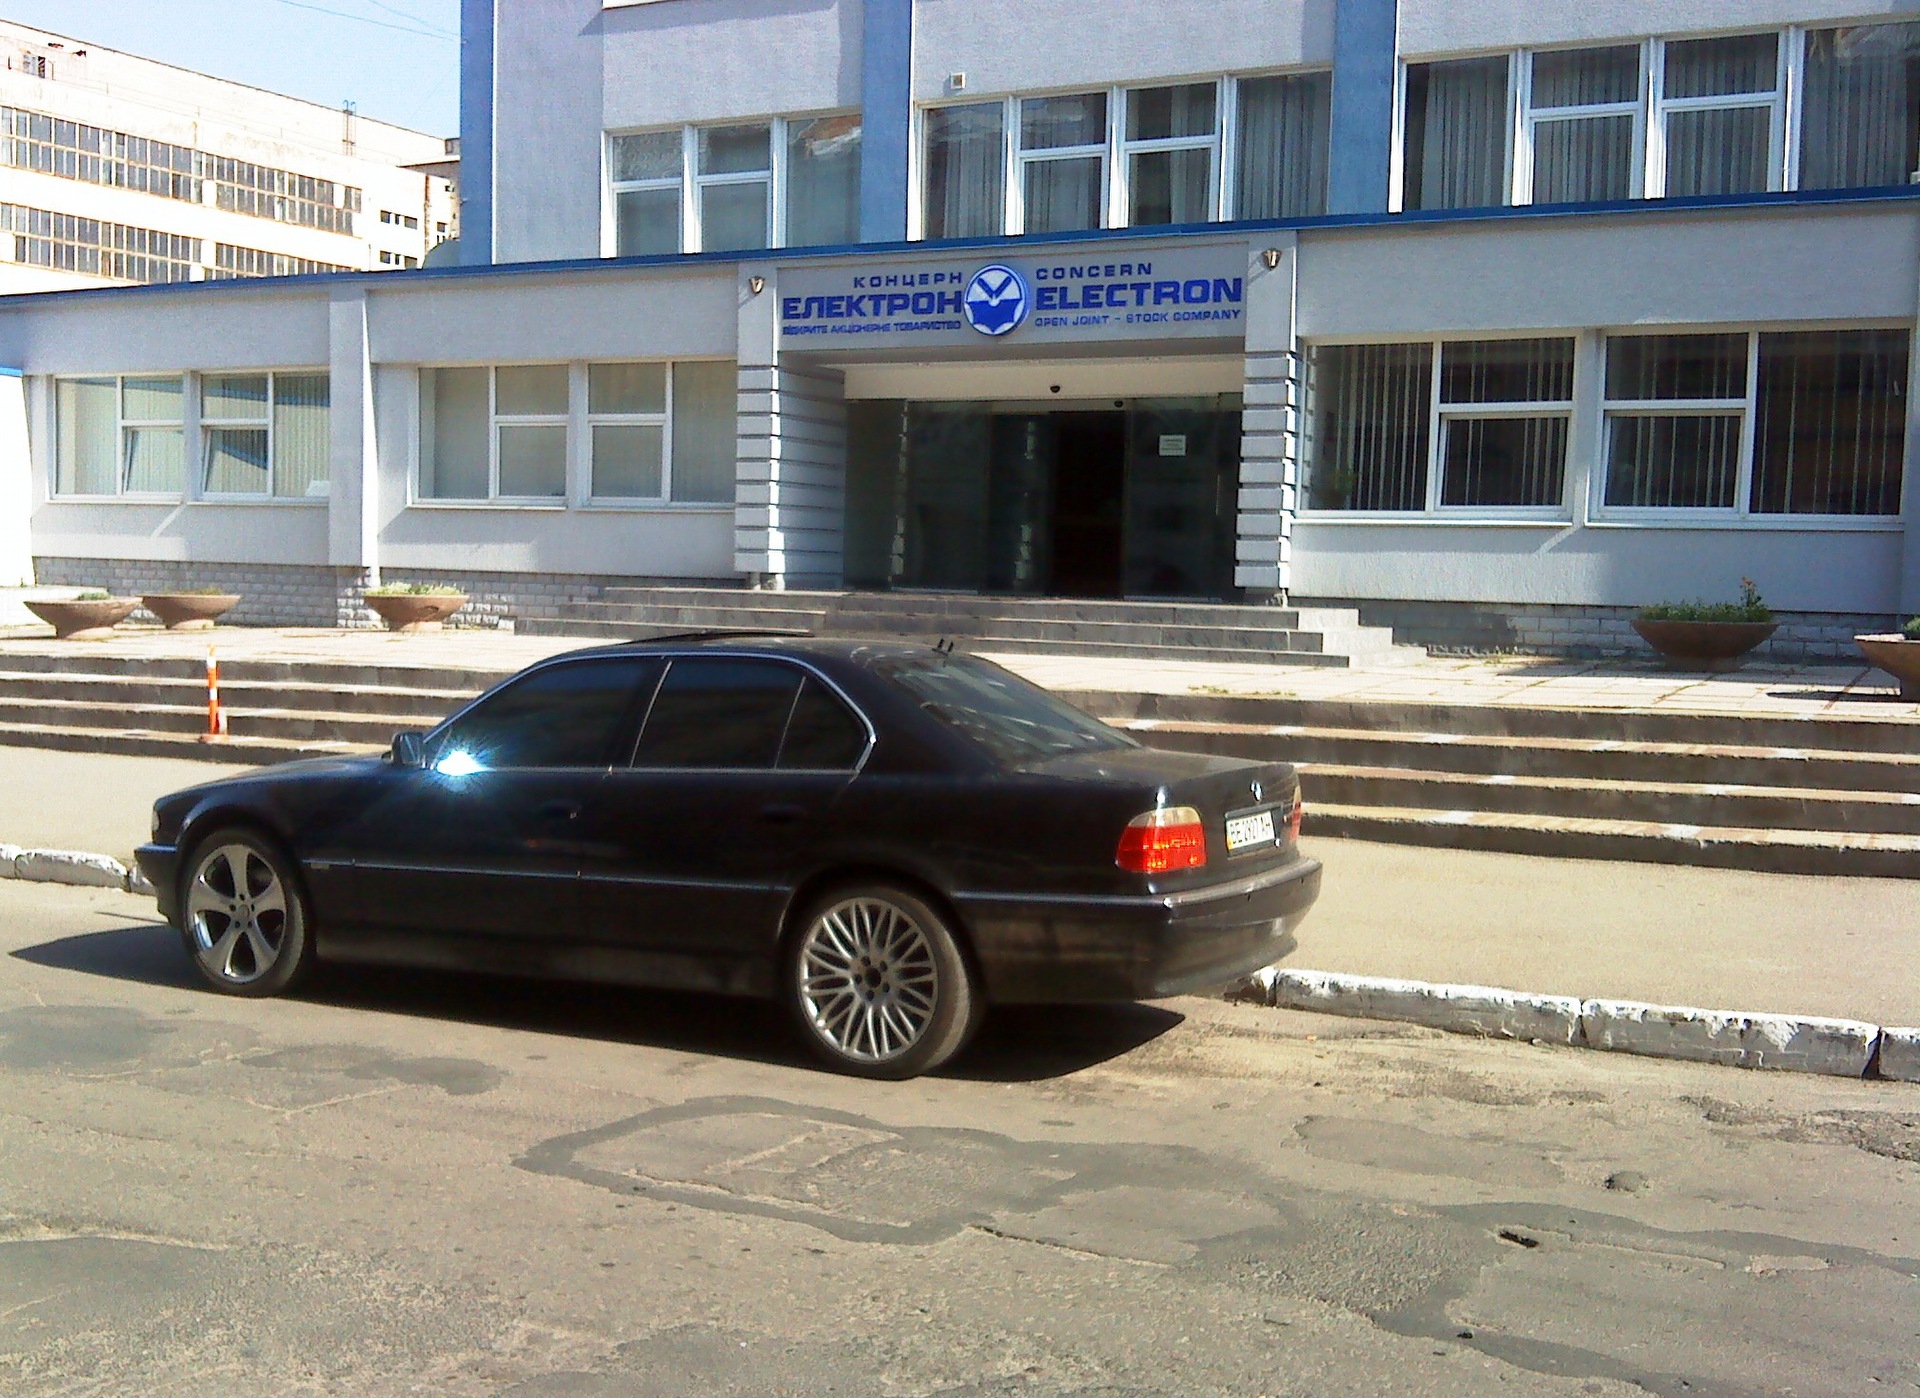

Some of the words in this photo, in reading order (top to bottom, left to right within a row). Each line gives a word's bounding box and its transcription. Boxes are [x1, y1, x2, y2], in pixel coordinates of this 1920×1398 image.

[1036, 263, 1152, 280] CONCERN
[854, 272, 962, 289] КОНЦЕРН
[1036, 278, 1242, 311] ELECTRON
[783, 291, 962, 320] ЕЛЕКТРОН
[893, 320, 962, 332] ТОВАРИСТВО
[1035, 316, 1068, 327] OPEN
[1072, 315, 1109, 327] JOINT
[1126, 312, 1169, 323] STOCK
[1173, 309, 1241, 322] COMPANY
